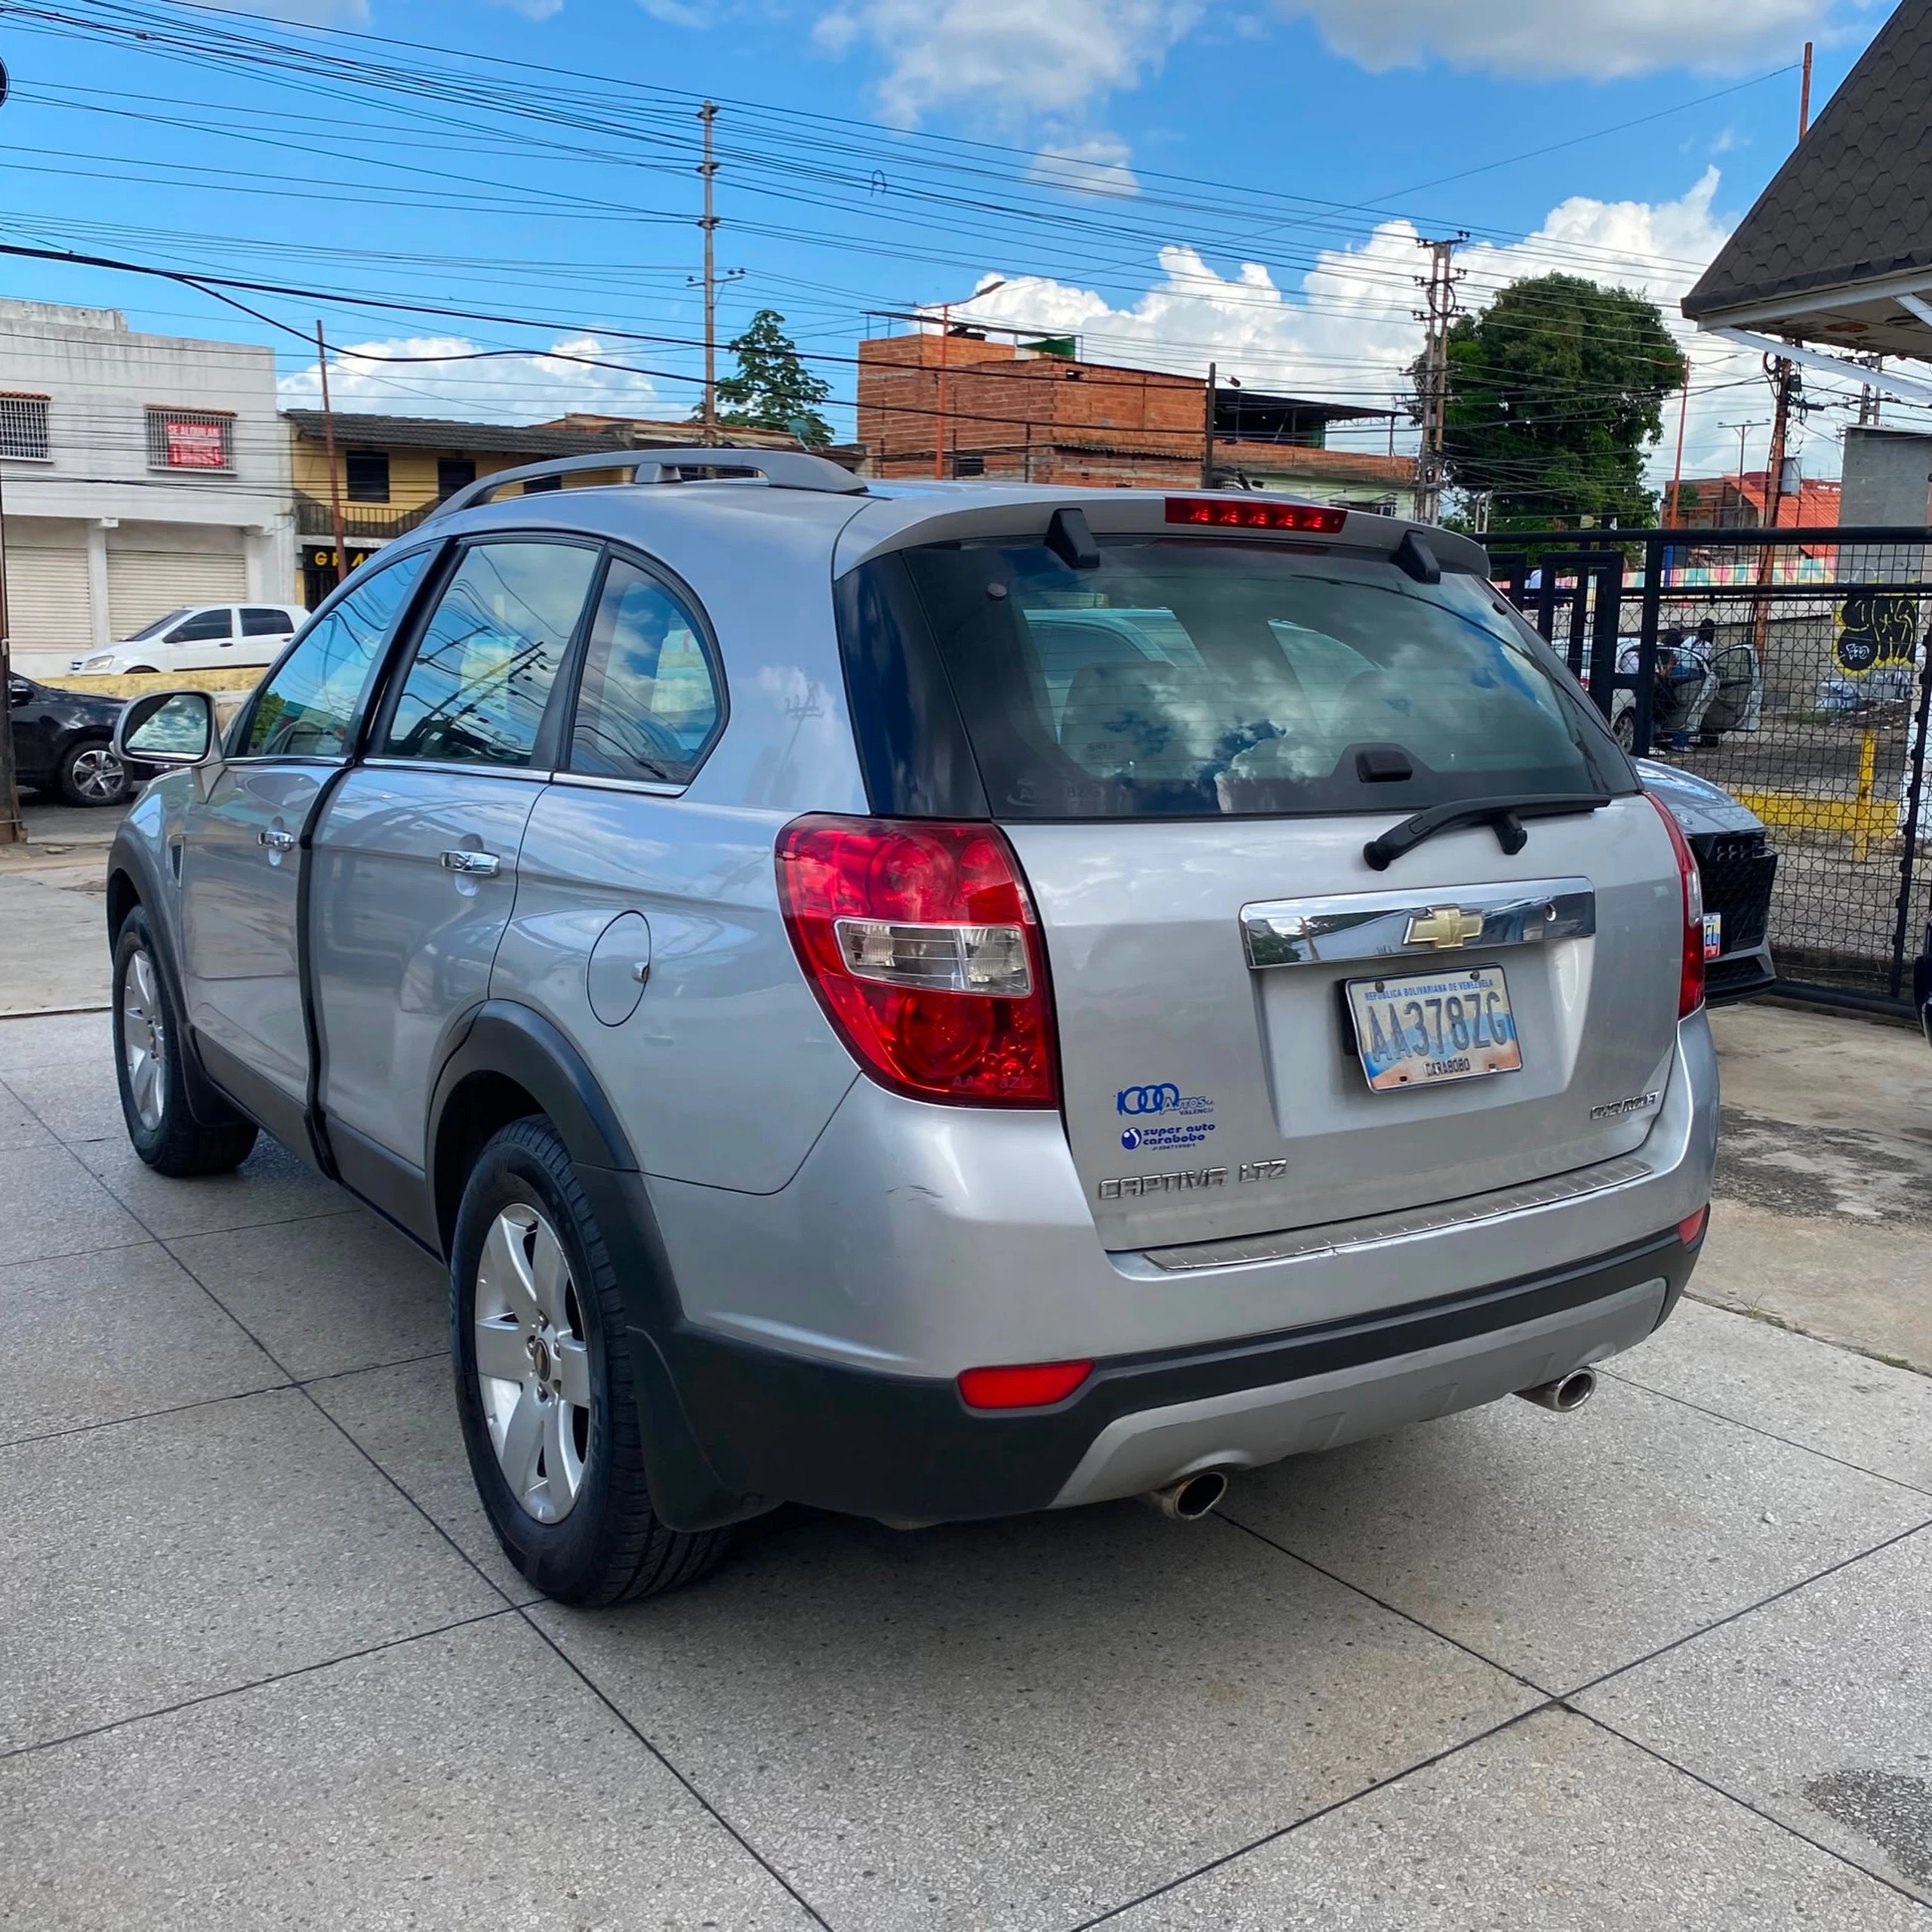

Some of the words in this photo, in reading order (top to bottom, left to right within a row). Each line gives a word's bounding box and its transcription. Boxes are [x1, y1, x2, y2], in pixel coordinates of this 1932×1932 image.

[168, 424, 180, 436] SE
[1404, 984, 1447, 997] BOLIVARIANA
[1449, 983, 1457, 991] DE
[1459, 979, 1494, 990] VENEZUELA
[1367, 991, 1508, 1063] AA378ZG
[1424, 1058, 1471, 1077] CARABOBO
[1142, 1132, 1206, 1146] carabobo
[1143, 1126, 1182, 1137] super
[1186, 1123, 1216, 1132] auto
[1099, 1166, 1228, 1200] CAPTIVA
[1240, 1158, 1287, 1183] LTZ
